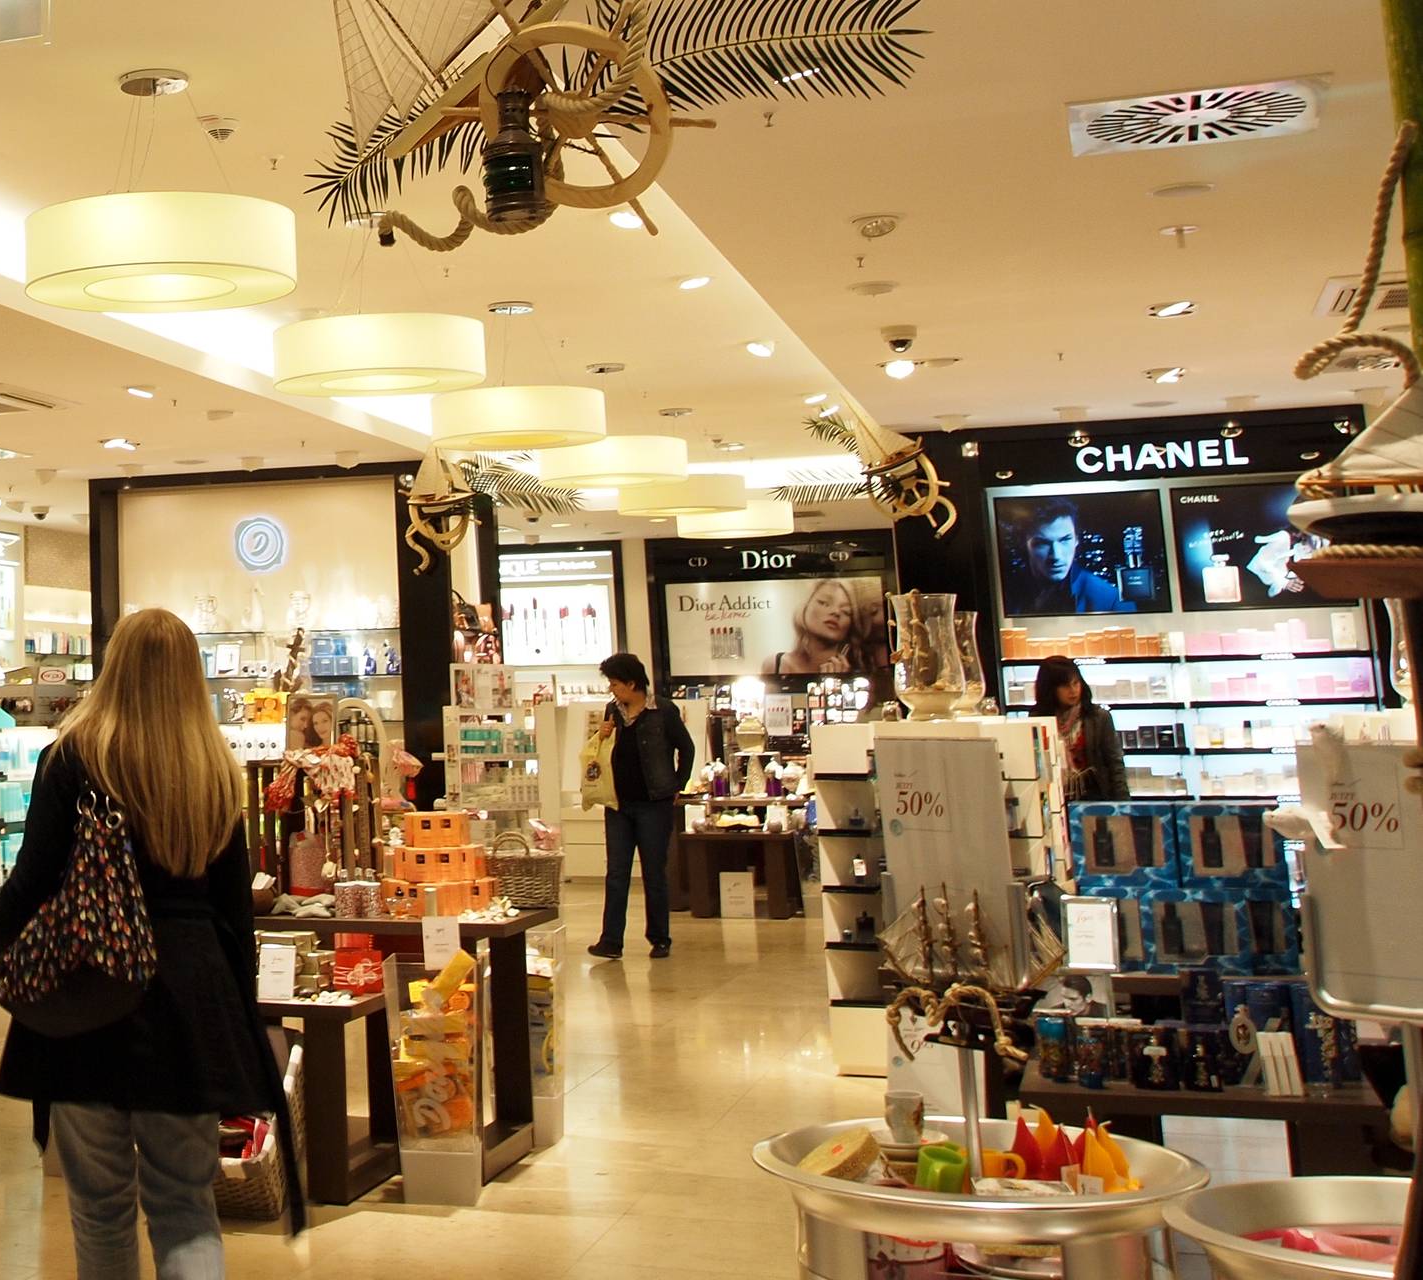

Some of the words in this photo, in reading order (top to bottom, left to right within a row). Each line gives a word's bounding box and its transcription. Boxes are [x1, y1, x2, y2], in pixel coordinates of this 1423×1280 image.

[1075, 439, 1250, 474] CHANEL
[1179, 495, 1220, 504] CHANEL
[740, 550, 796, 570] Dior
[679, 595, 717, 612] Dior
[718, 595, 771, 611] Addict
[896, 791, 944, 817] 50%
[1332, 802, 1399, 833] 50%
